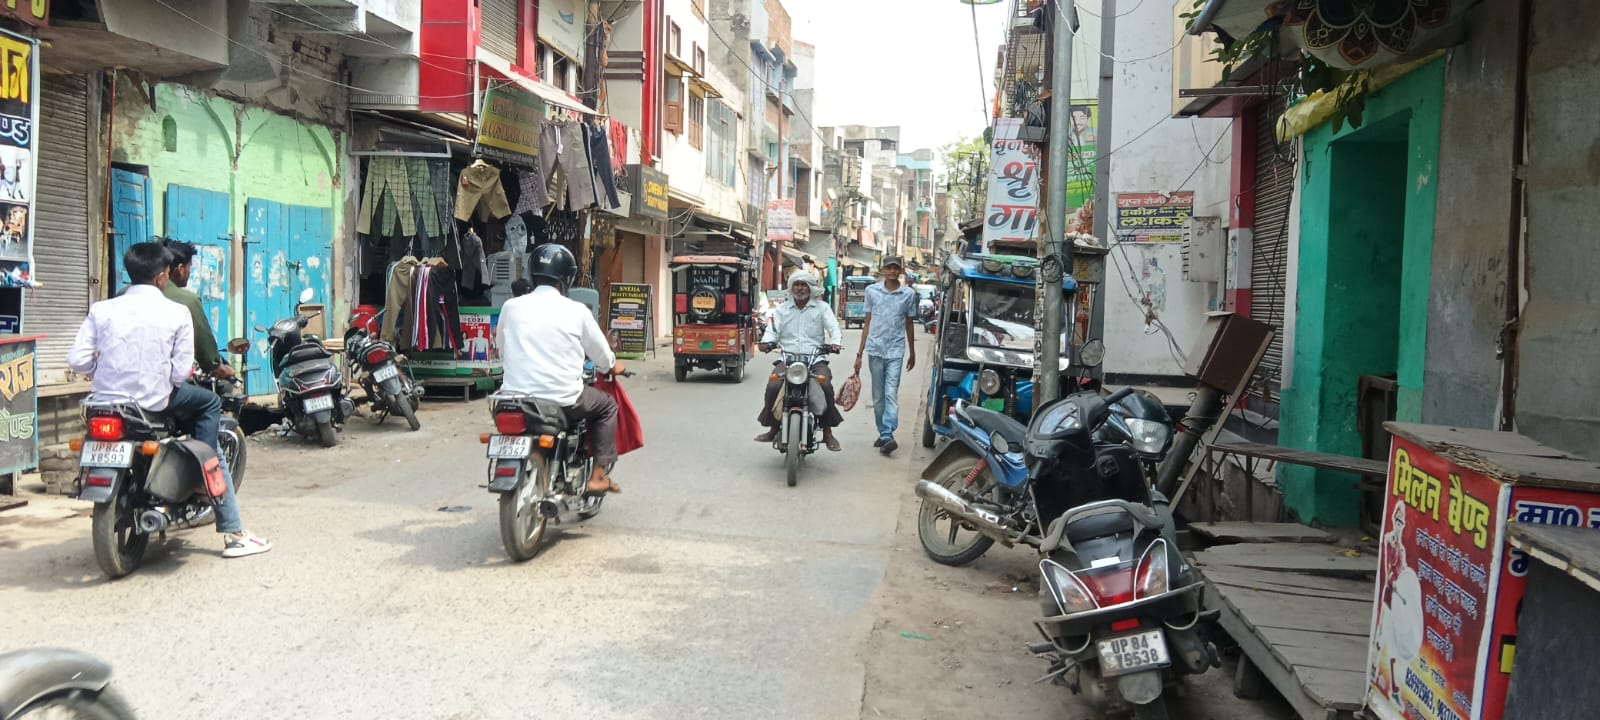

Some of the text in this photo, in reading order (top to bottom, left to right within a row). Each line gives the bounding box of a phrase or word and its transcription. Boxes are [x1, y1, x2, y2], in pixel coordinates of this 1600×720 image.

[1392, 447, 1442, 522] मिलन
[1111, 635, 1149, 655] UP 84
